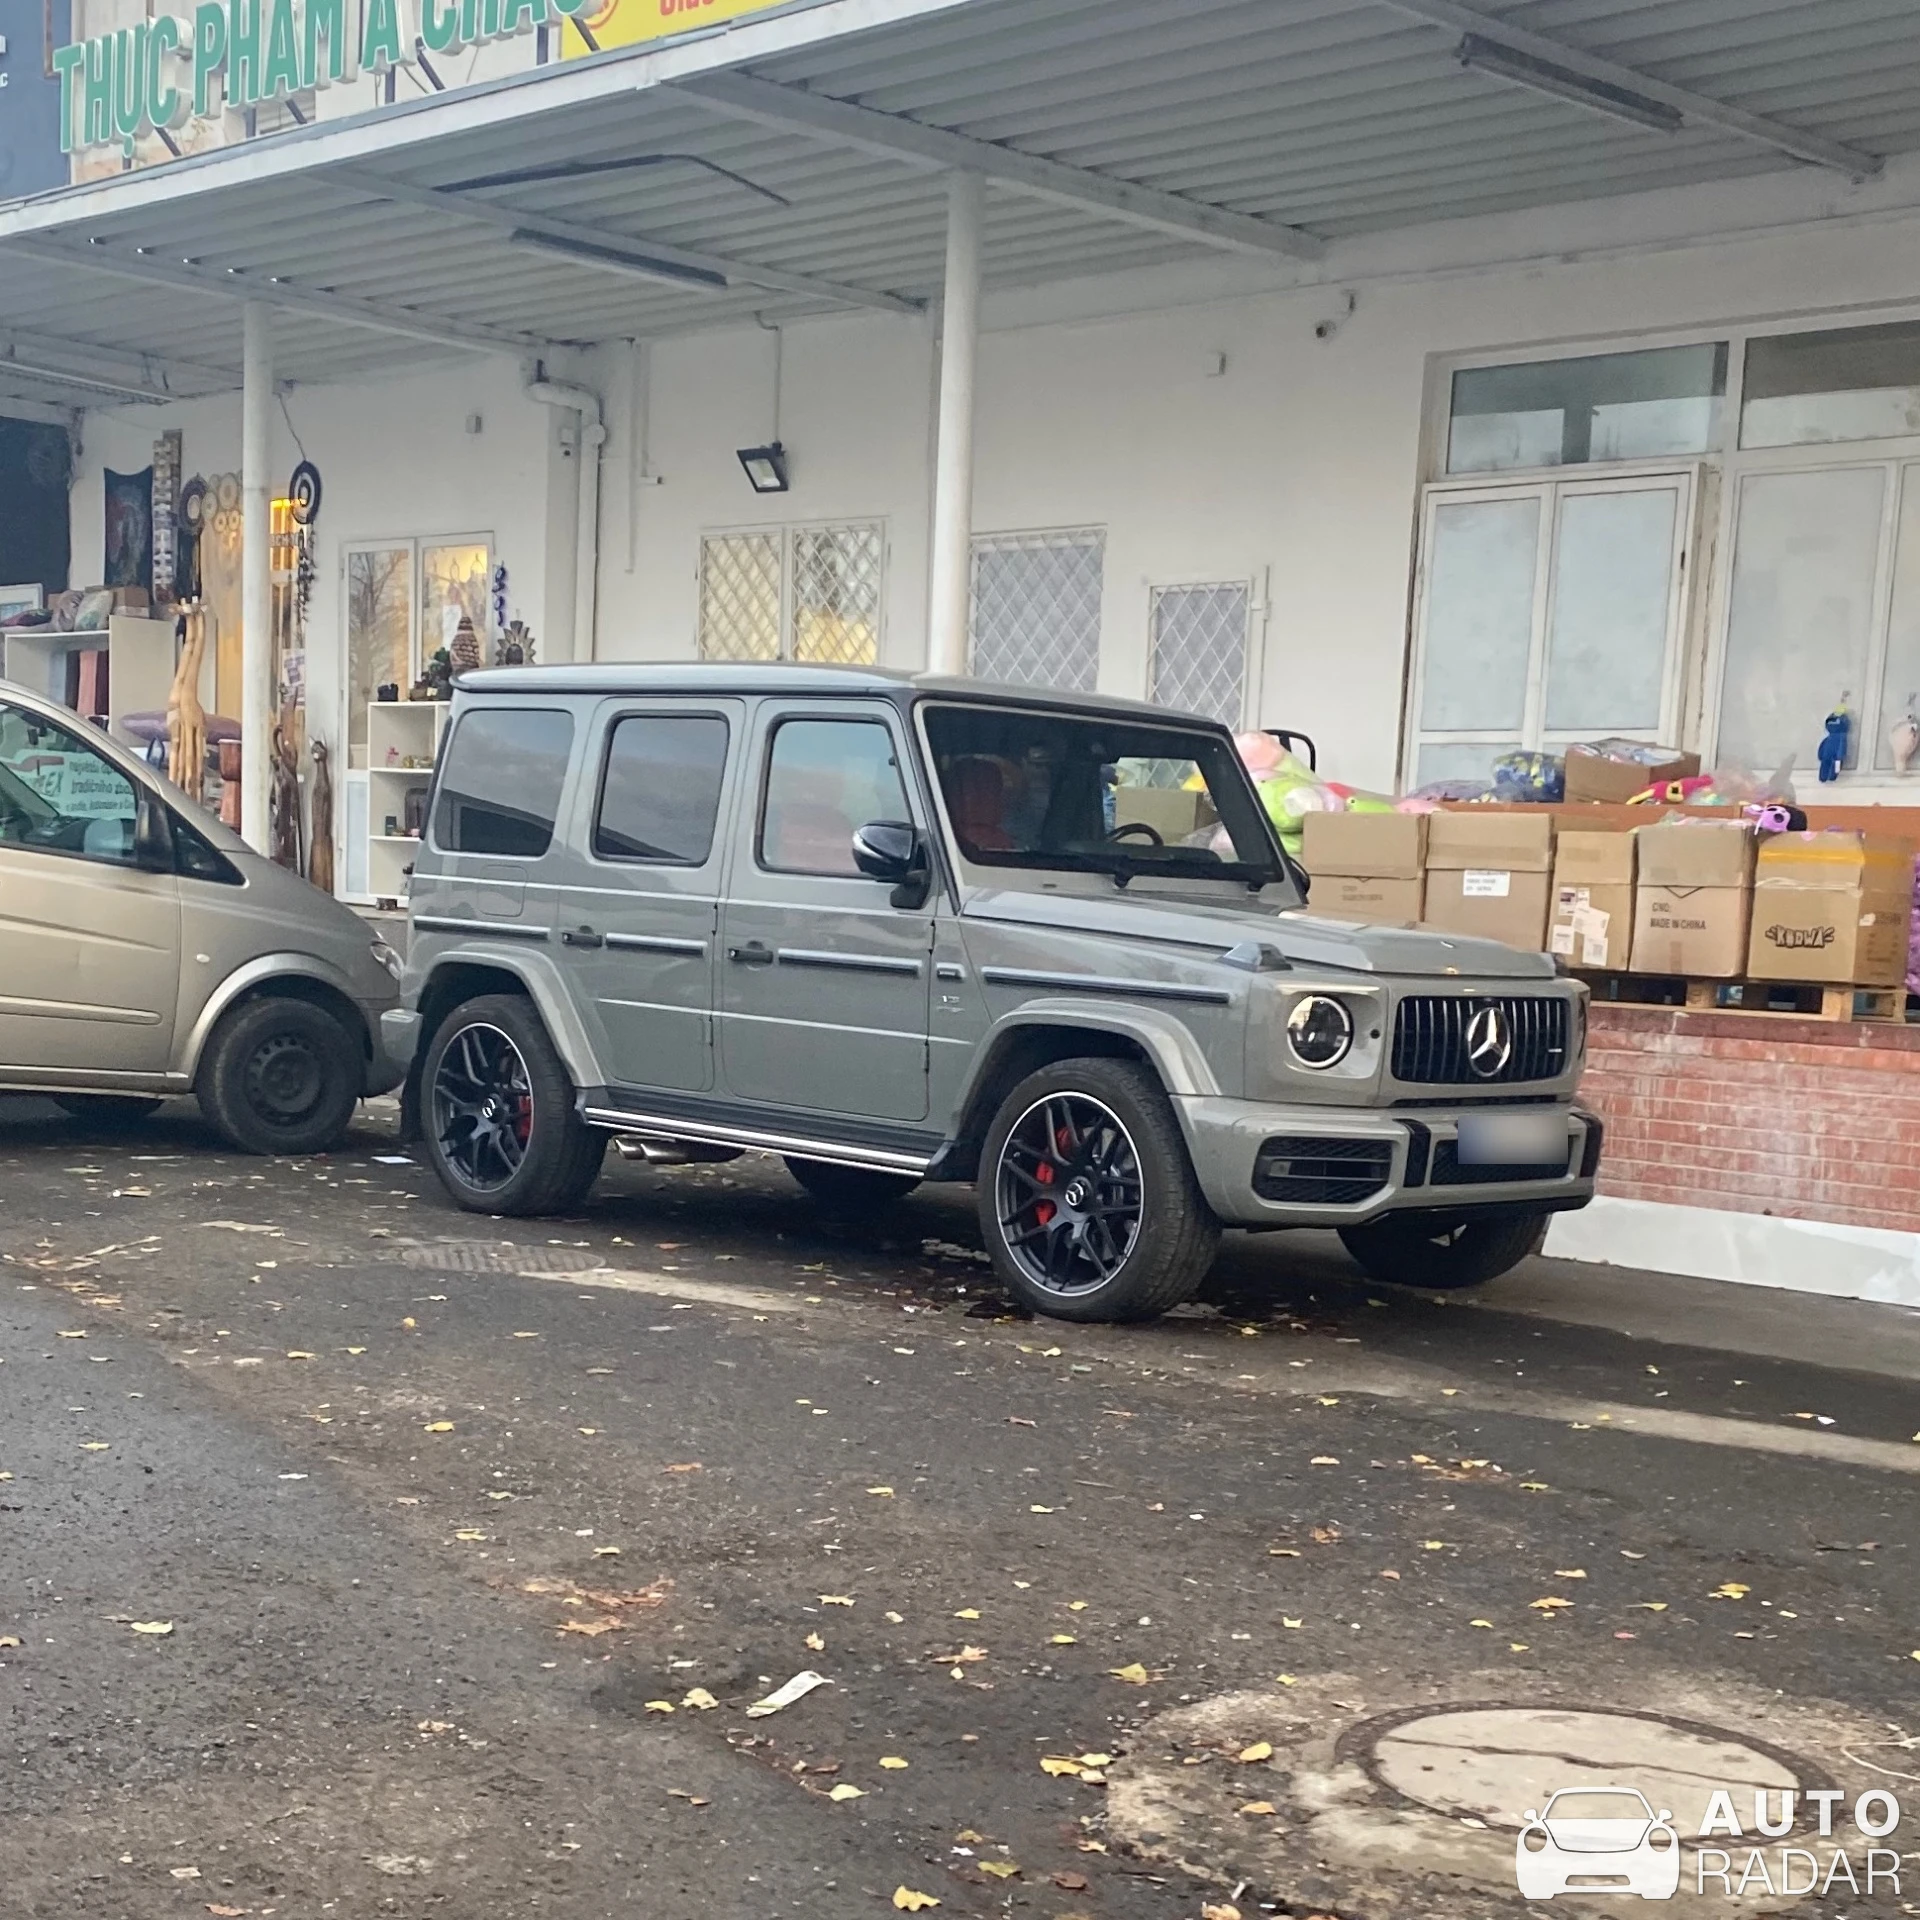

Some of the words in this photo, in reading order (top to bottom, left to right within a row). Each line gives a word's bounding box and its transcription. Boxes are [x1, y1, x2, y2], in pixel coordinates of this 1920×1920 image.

[1650, 917, 1670, 928] MADE
[1672, 919, 1679, 929] IN
[1681, 919, 1706, 930] CHINA
